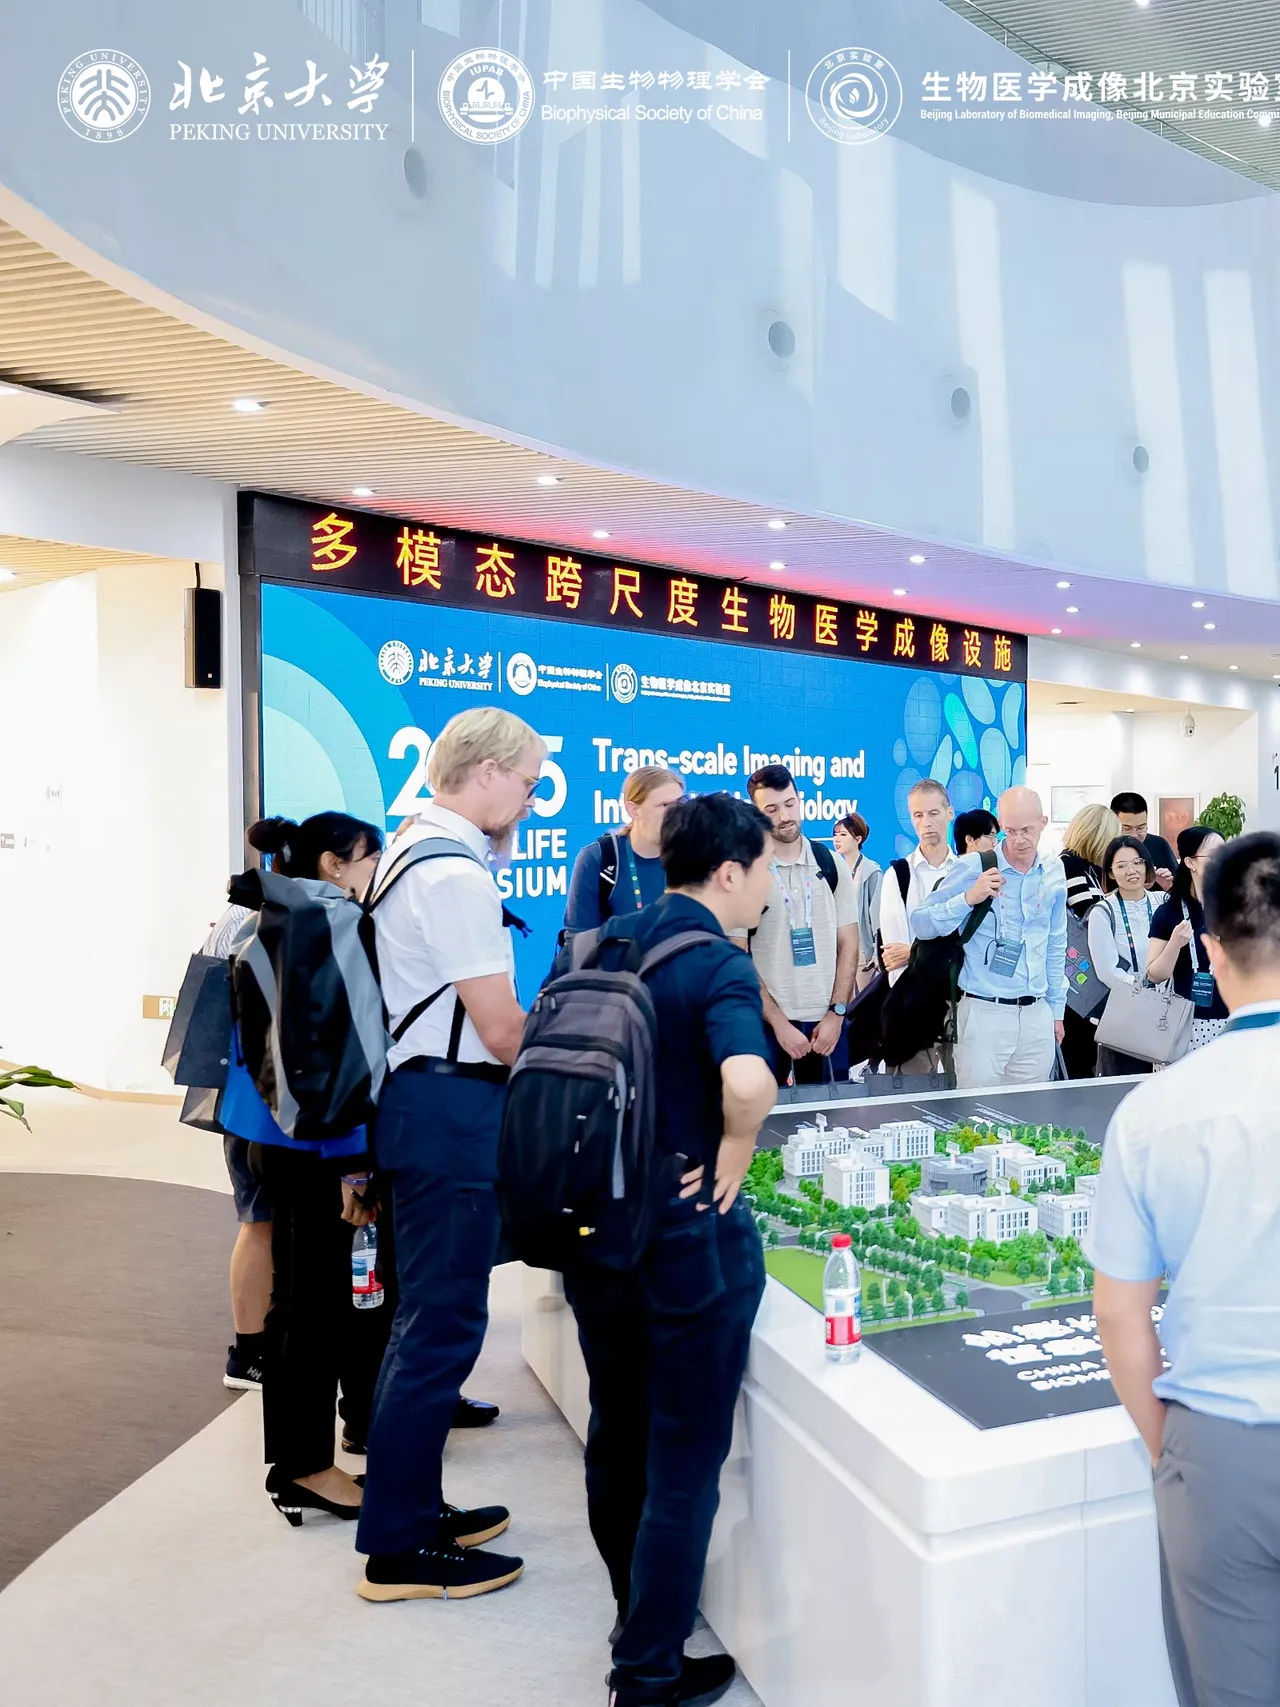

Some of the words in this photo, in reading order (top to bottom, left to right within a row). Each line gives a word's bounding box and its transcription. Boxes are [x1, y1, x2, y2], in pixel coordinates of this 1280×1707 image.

[311, 512, 1012, 673] 多模态跨尺度生物医学成像设施
[418, 677, 448, 688] PEKING
[448, 679, 494, 691] UNIVERSITY
[830, 750, 865, 779] and
[1030, 1369, 1112, 1392] BIOME
